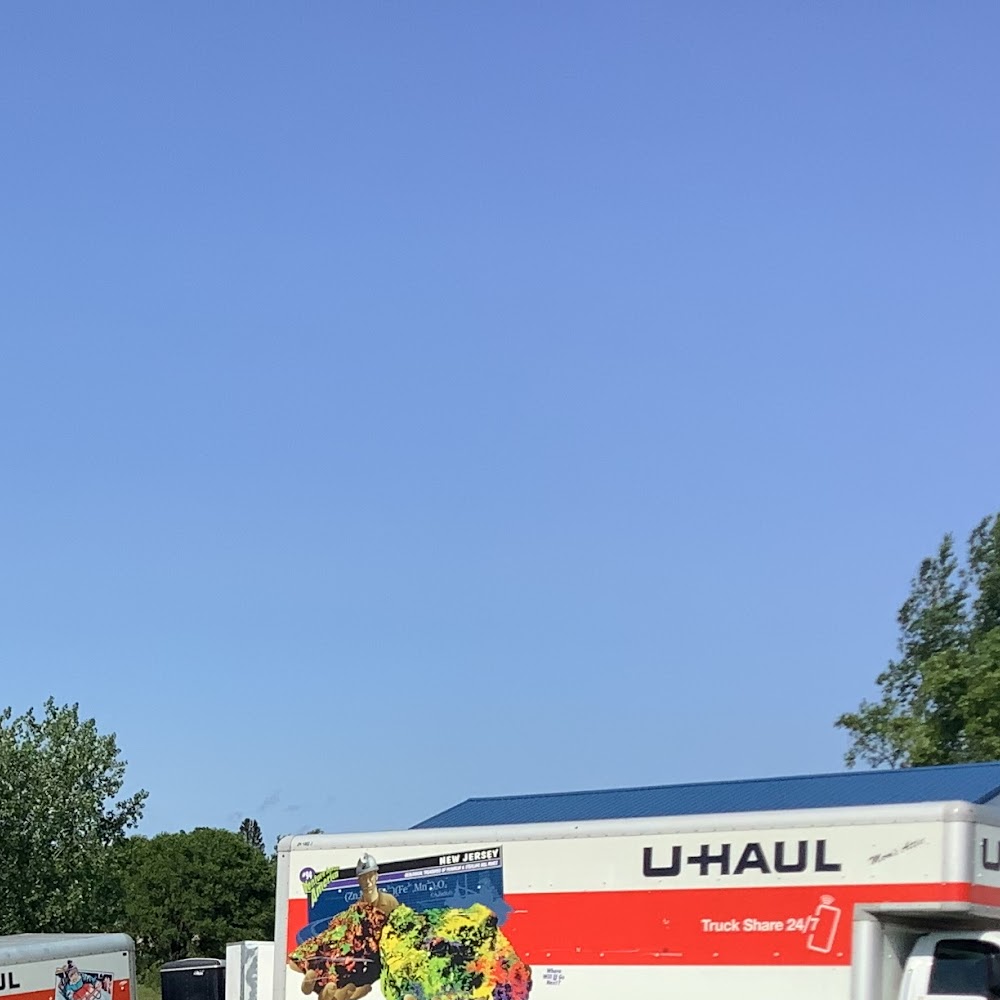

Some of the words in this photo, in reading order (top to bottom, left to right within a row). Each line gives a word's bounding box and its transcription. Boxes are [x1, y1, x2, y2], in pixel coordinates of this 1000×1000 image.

[439, 854, 460, 865] NEW
[462, 848, 499, 862] JERSEY
[643, 839, 842, 877] U-HAUL
[701, 918, 740, 932] Truck
[742, 918, 784, 932] Share
[786, 915, 820, 933] 24/7
